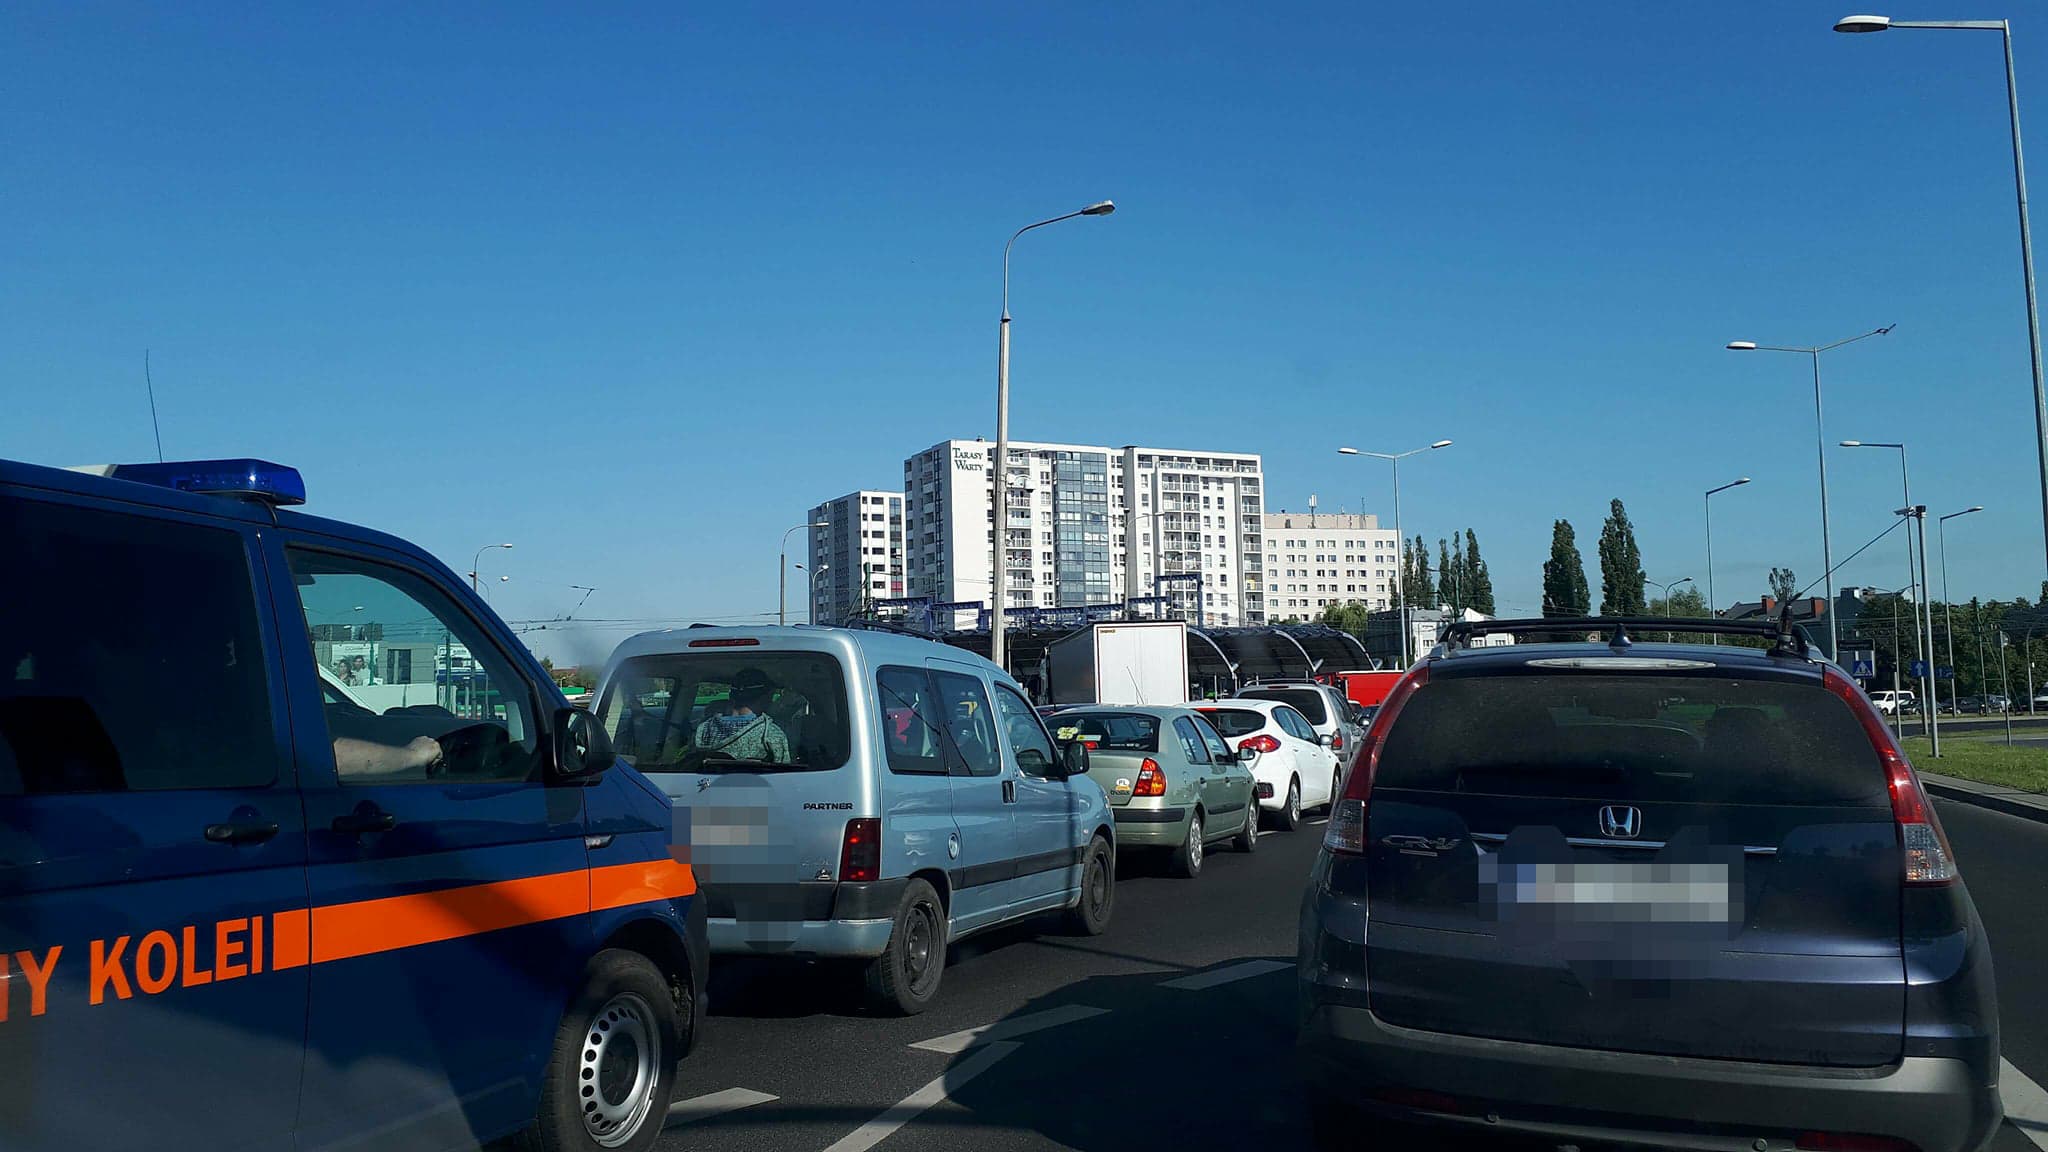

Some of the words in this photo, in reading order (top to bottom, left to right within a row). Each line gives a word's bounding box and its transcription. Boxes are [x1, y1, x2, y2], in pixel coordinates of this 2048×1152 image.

[954, 459, 983, 471] WARTY
[803, 802, 854, 811] PARTNER
[89, 915, 264, 1006] KOLEI
